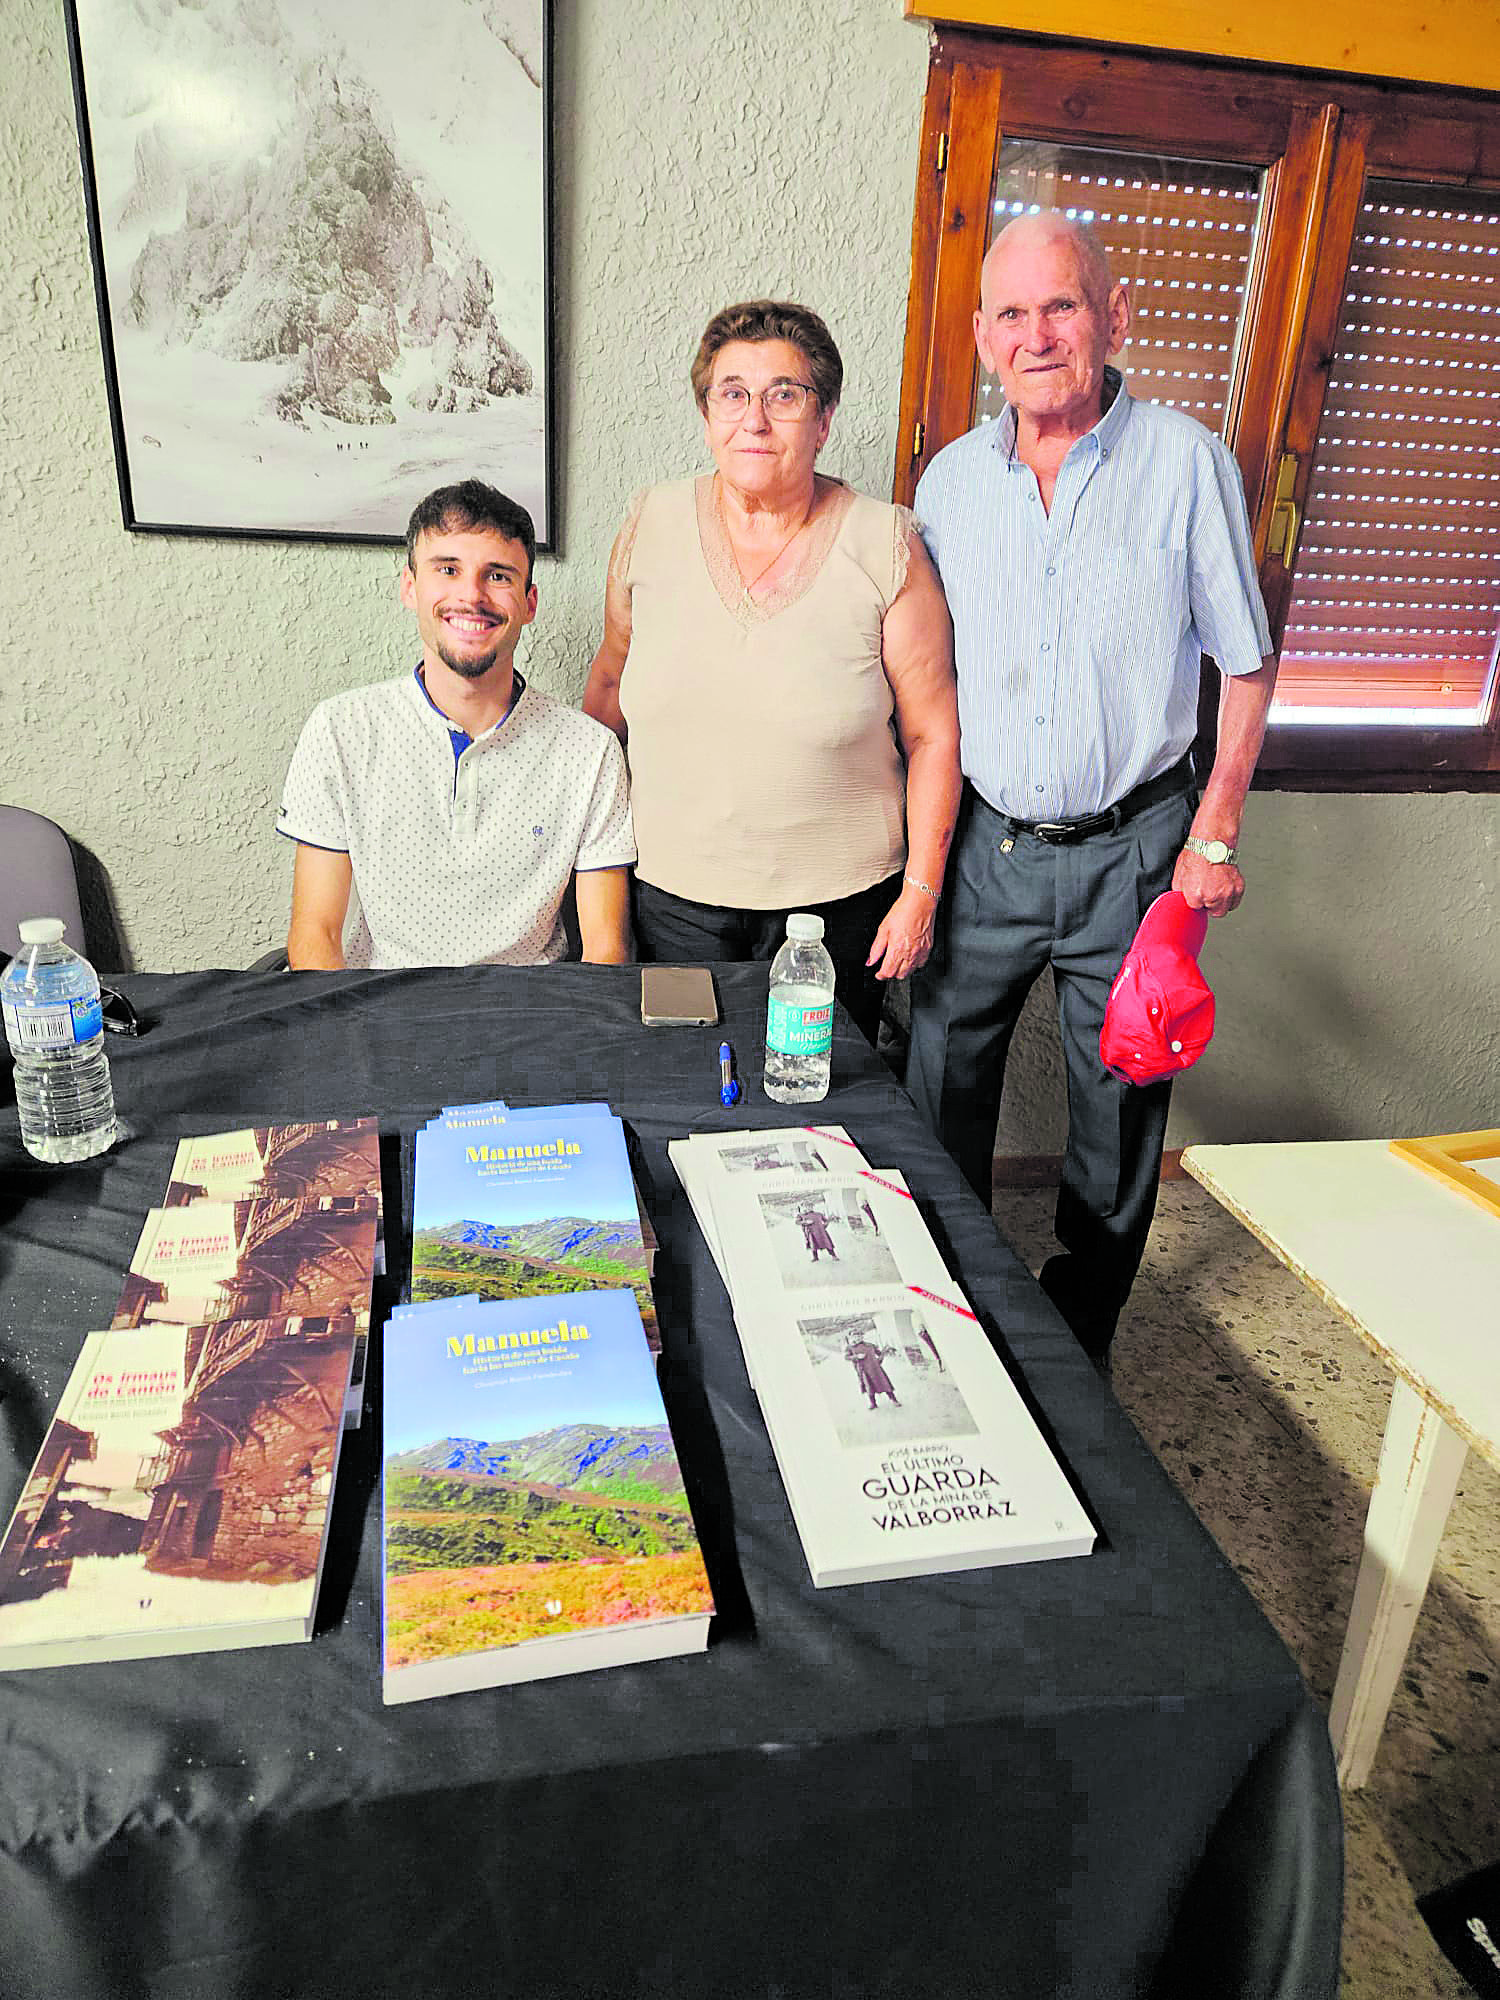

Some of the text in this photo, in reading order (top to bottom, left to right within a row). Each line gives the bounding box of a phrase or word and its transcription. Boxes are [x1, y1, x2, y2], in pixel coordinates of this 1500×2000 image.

[445, 1115, 507, 1129] Manuela
[465, 1138, 583, 1163] Manuela
[447, 1320, 591, 1358] Manuela
[94, 1374, 113, 1384] Os
[881, 1462, 901, 1474] EL
[862, 1467, 1000, 1500] GUARDA
[888, 1489, 992, 1511] DE LA MINA DE
[872, 1501, 1018, 1531] VALBORRAZ
